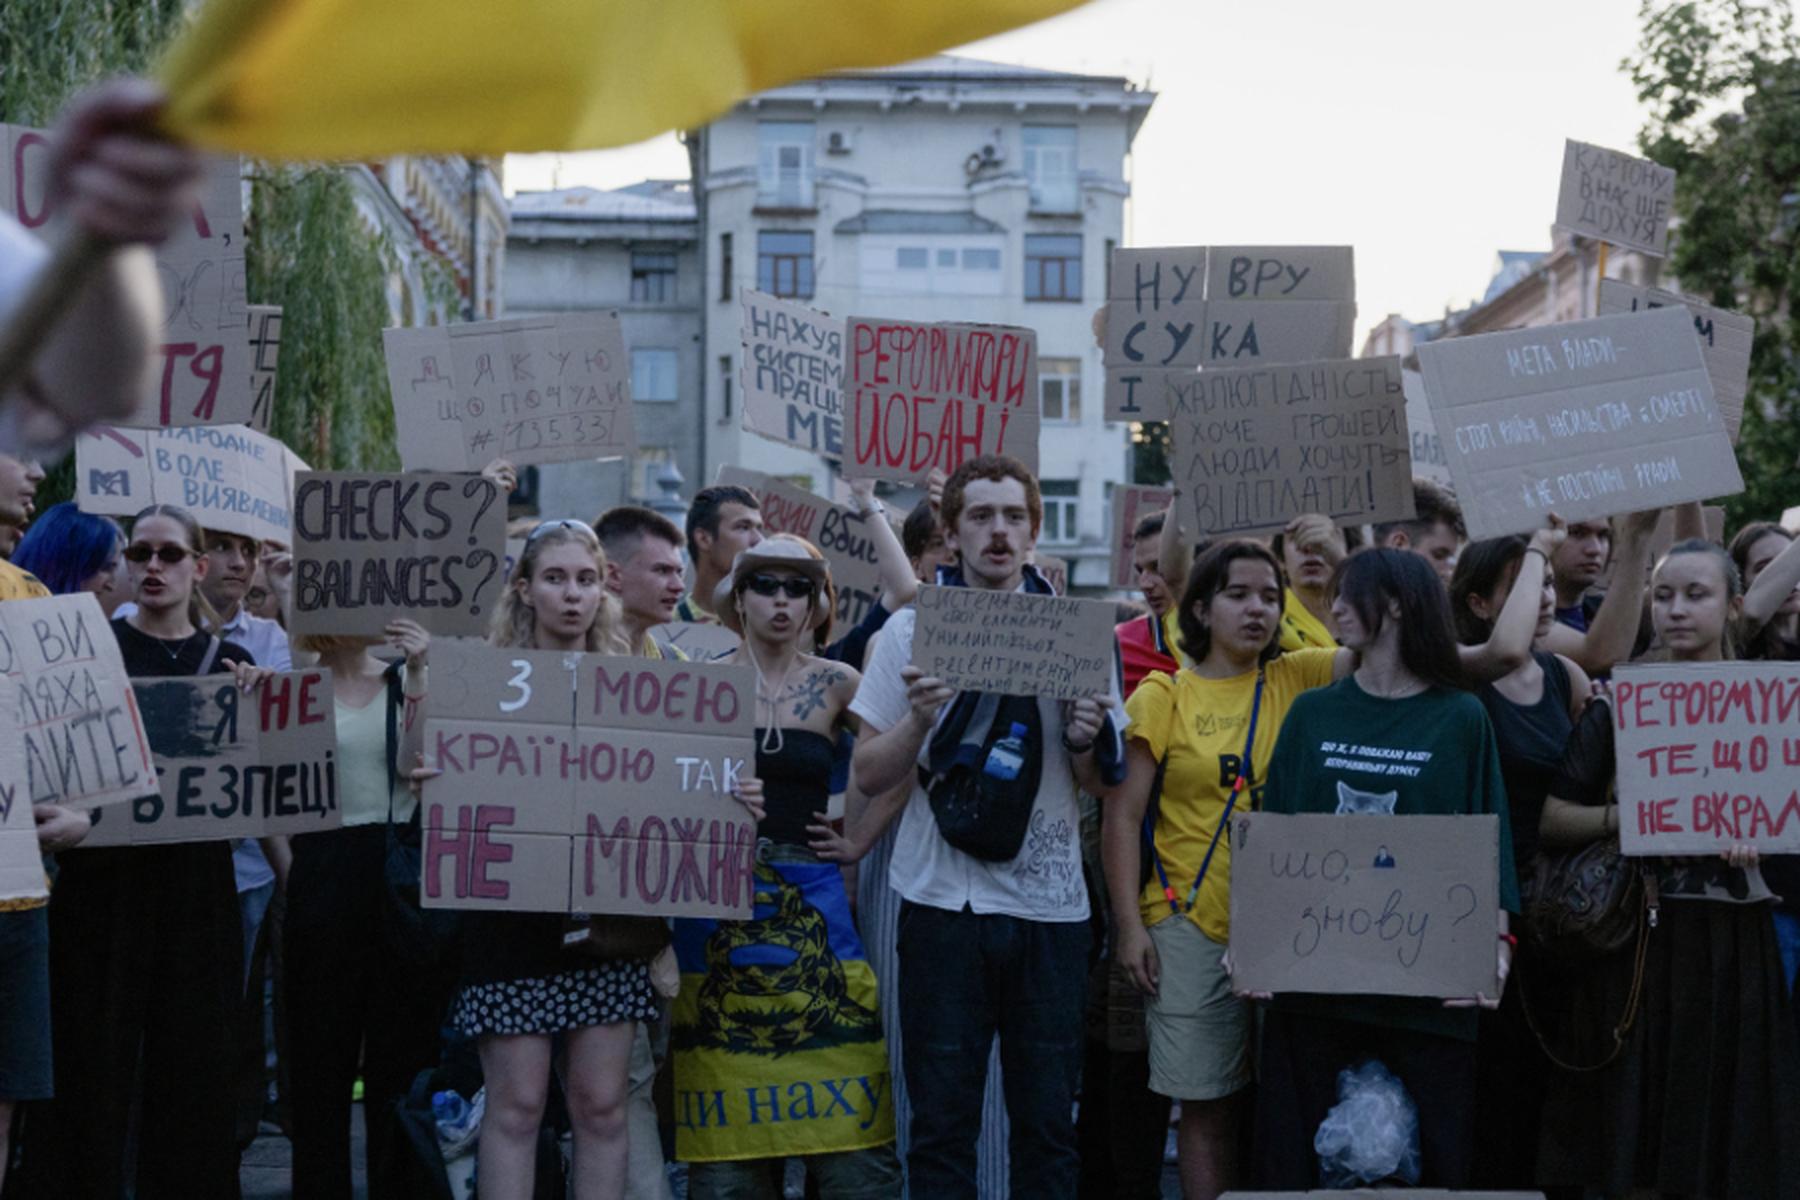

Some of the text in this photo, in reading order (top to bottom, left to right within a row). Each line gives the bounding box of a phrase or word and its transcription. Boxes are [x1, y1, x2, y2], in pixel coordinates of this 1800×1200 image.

[1574, 145, 1669, 193] КАРТОНУ
[1577, 200, 1657, 244] ДОХУЯ
[1135, 256, 1310, 313] НУ ВРУ
[751, 305, 841, 358] НАХУЯ
[1122, 320, 1260, 365] СУКА
[411, 350, 612, 391] ДЯКУЮ
[854, 323, 1029, 408] РЕФОРМАТОРИ
[438, 397, 485, 423] ЩО
[1190, 406, 1399, 444] ХОЧЕ ГРОШЕЙ
[1188, 447, 1280, 481] ЛЮДИ
[261, 673, 325, 732] НЕ
[594, 666, 739, 723] МОЄЮ
[435, 731, 744, 793] КРАЇНОЮ ТАК
[1638, 798, 1684, 836] НЕ
[425, 803, 515, 900] НЕ
